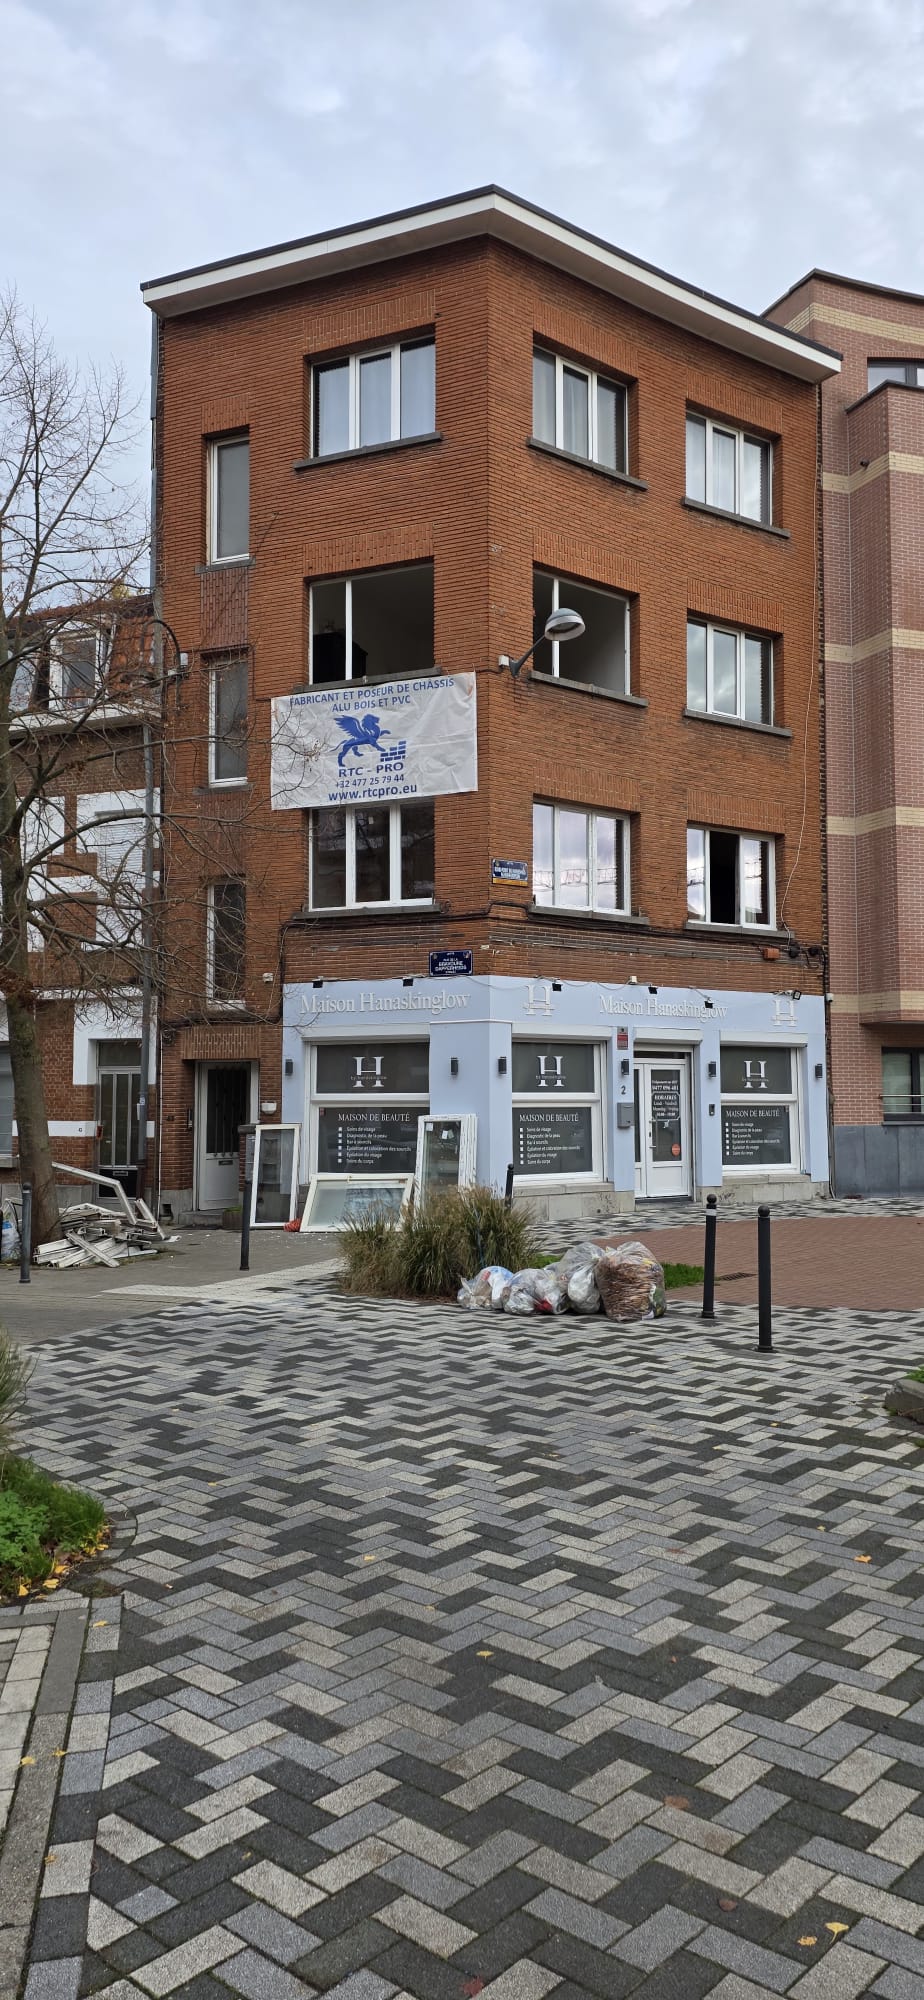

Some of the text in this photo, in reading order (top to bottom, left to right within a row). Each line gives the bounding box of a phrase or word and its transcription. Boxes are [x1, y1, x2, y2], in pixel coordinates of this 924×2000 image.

[290, 692, 339, 706] FABRICANT
[343, 692, 354, 700] ET
[357, 686, 393, 699] POSEUR
[397, 684, 409, 693] DE
[332, 695, 411, 712] ALU BOIS ET PVC
[338, 767, 363, 777] RTC
[376, 762, 404, 773] PRO
[335, 774, 404, 788] +32 477 25 79 44
[328, 784, 417, 800] www.rtcpro.eu
[300, 989, 471, 1015] Maison Hanaskinglow
[600, 995, 643, 1015] Maison
[352, 1056, 384, 1087] H
[537, 1055, 565, 1087] H
[744, 1061, 768, 1088] H
[621, 1085, 626, 1095] 2
[338, 1112, 410, 1121] MAISON DE BEAUTÉ
[555, 1112, 579, 1121] BEAUTÉ
